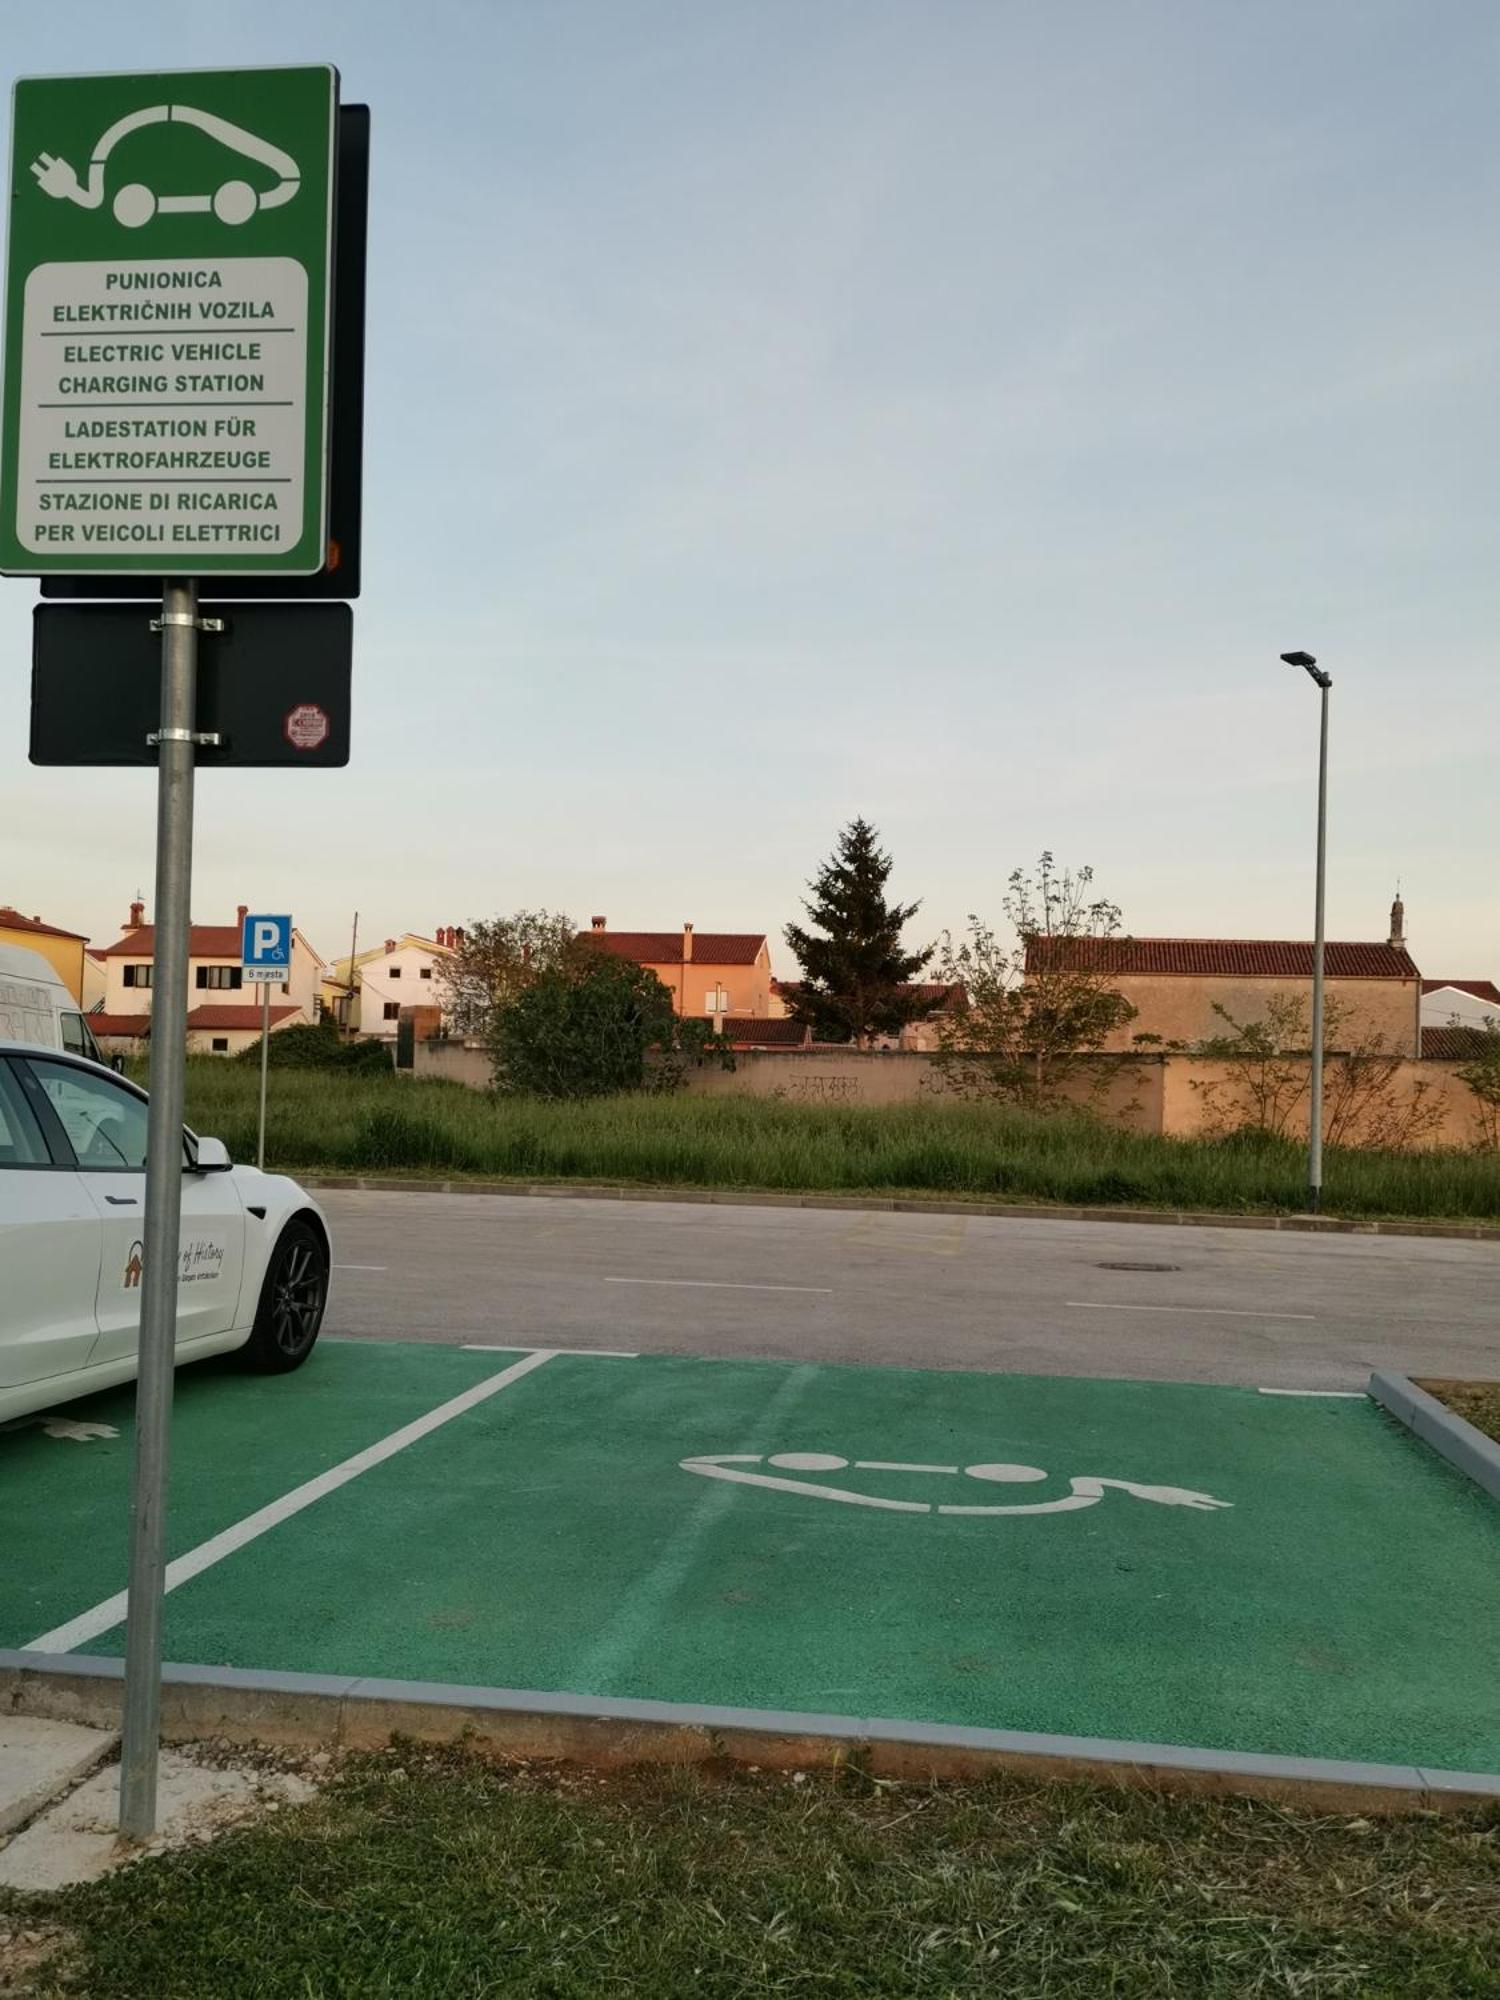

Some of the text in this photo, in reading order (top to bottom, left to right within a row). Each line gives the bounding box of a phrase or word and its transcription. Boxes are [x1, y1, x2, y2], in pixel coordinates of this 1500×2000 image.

[106, 271, 222, 290] PUNIONICA
[53, 300, 275, 323] ELEKTRIČNIH VOZILA
[63, 343, 262, 363] ELECTRIC VEHICLE
[59, 375, 264, 395] CHARGING STATION
[64, 415, 257, 439] LADESTATION FÜR
[48, 451, 271, 470] ELEKTROFAHRZEUGE
[39, 493, 278, 511] STAZIONE DI RICARICA
[34, 524, 281, 542] PER VEICOLI ELETTRICI
[254, 922, 280, 959] P
[194, 1240, 225, 1270] History
